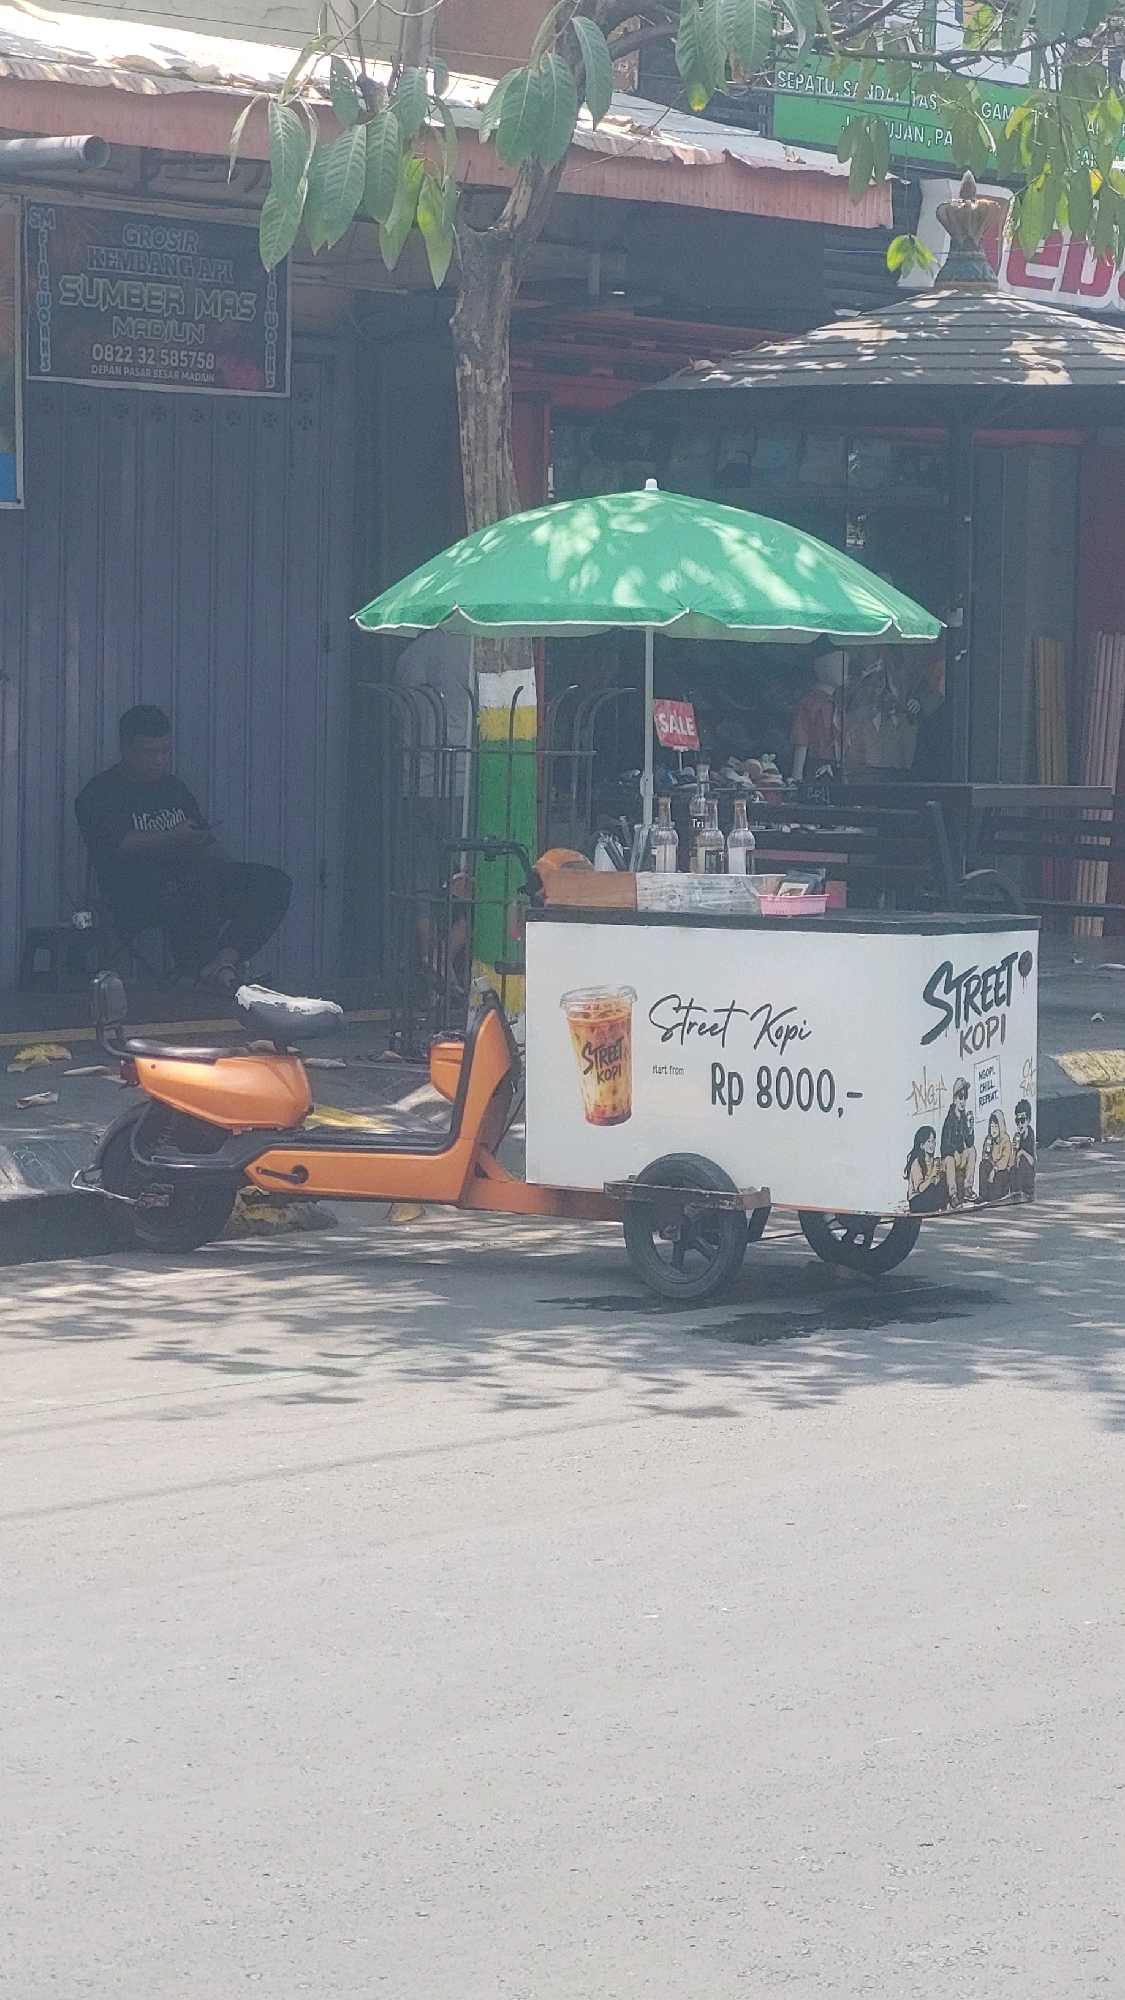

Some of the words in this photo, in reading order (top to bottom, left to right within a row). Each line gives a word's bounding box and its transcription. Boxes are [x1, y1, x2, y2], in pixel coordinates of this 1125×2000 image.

[28, 206, 57, 229] SM
[123, 223, 199, 254] GROSIR
[88, 245, 194, 279] KEMBANG
[199, 256, 234, 284] API
[59, 273, 185, 317] SUMBER
[195, 287, 257, 321] MAS
[112, 315, 205, 345] MADIUN
[92, 343, 133, 363] 0822
[137, 346, 156, 365] 32
[160, 348, 215, 370] 585758
[91, 364, 122, 376] DEPAN
[123, 366, 152, 378] PASAR
[152, 368, 180, 380] BESAR
[181, 371, 215, 383] MADIUN
[657, 713, 696, 737] SALE
[920, 951, 1018, 1045] STREET
[649, 993, 749, 1048] Street
[750, 1003, 812, 1055] Kopi
[959, 1013, 1007, 1060] KOPI
[581, 1036, 625, 1075] STREET
[652, 1064, 668, 1075] start
[669, 1065, 685, 1076] from
[596, 1065, 622, 1085] KOPI
[711, 1062, 744, 1115] Rp
